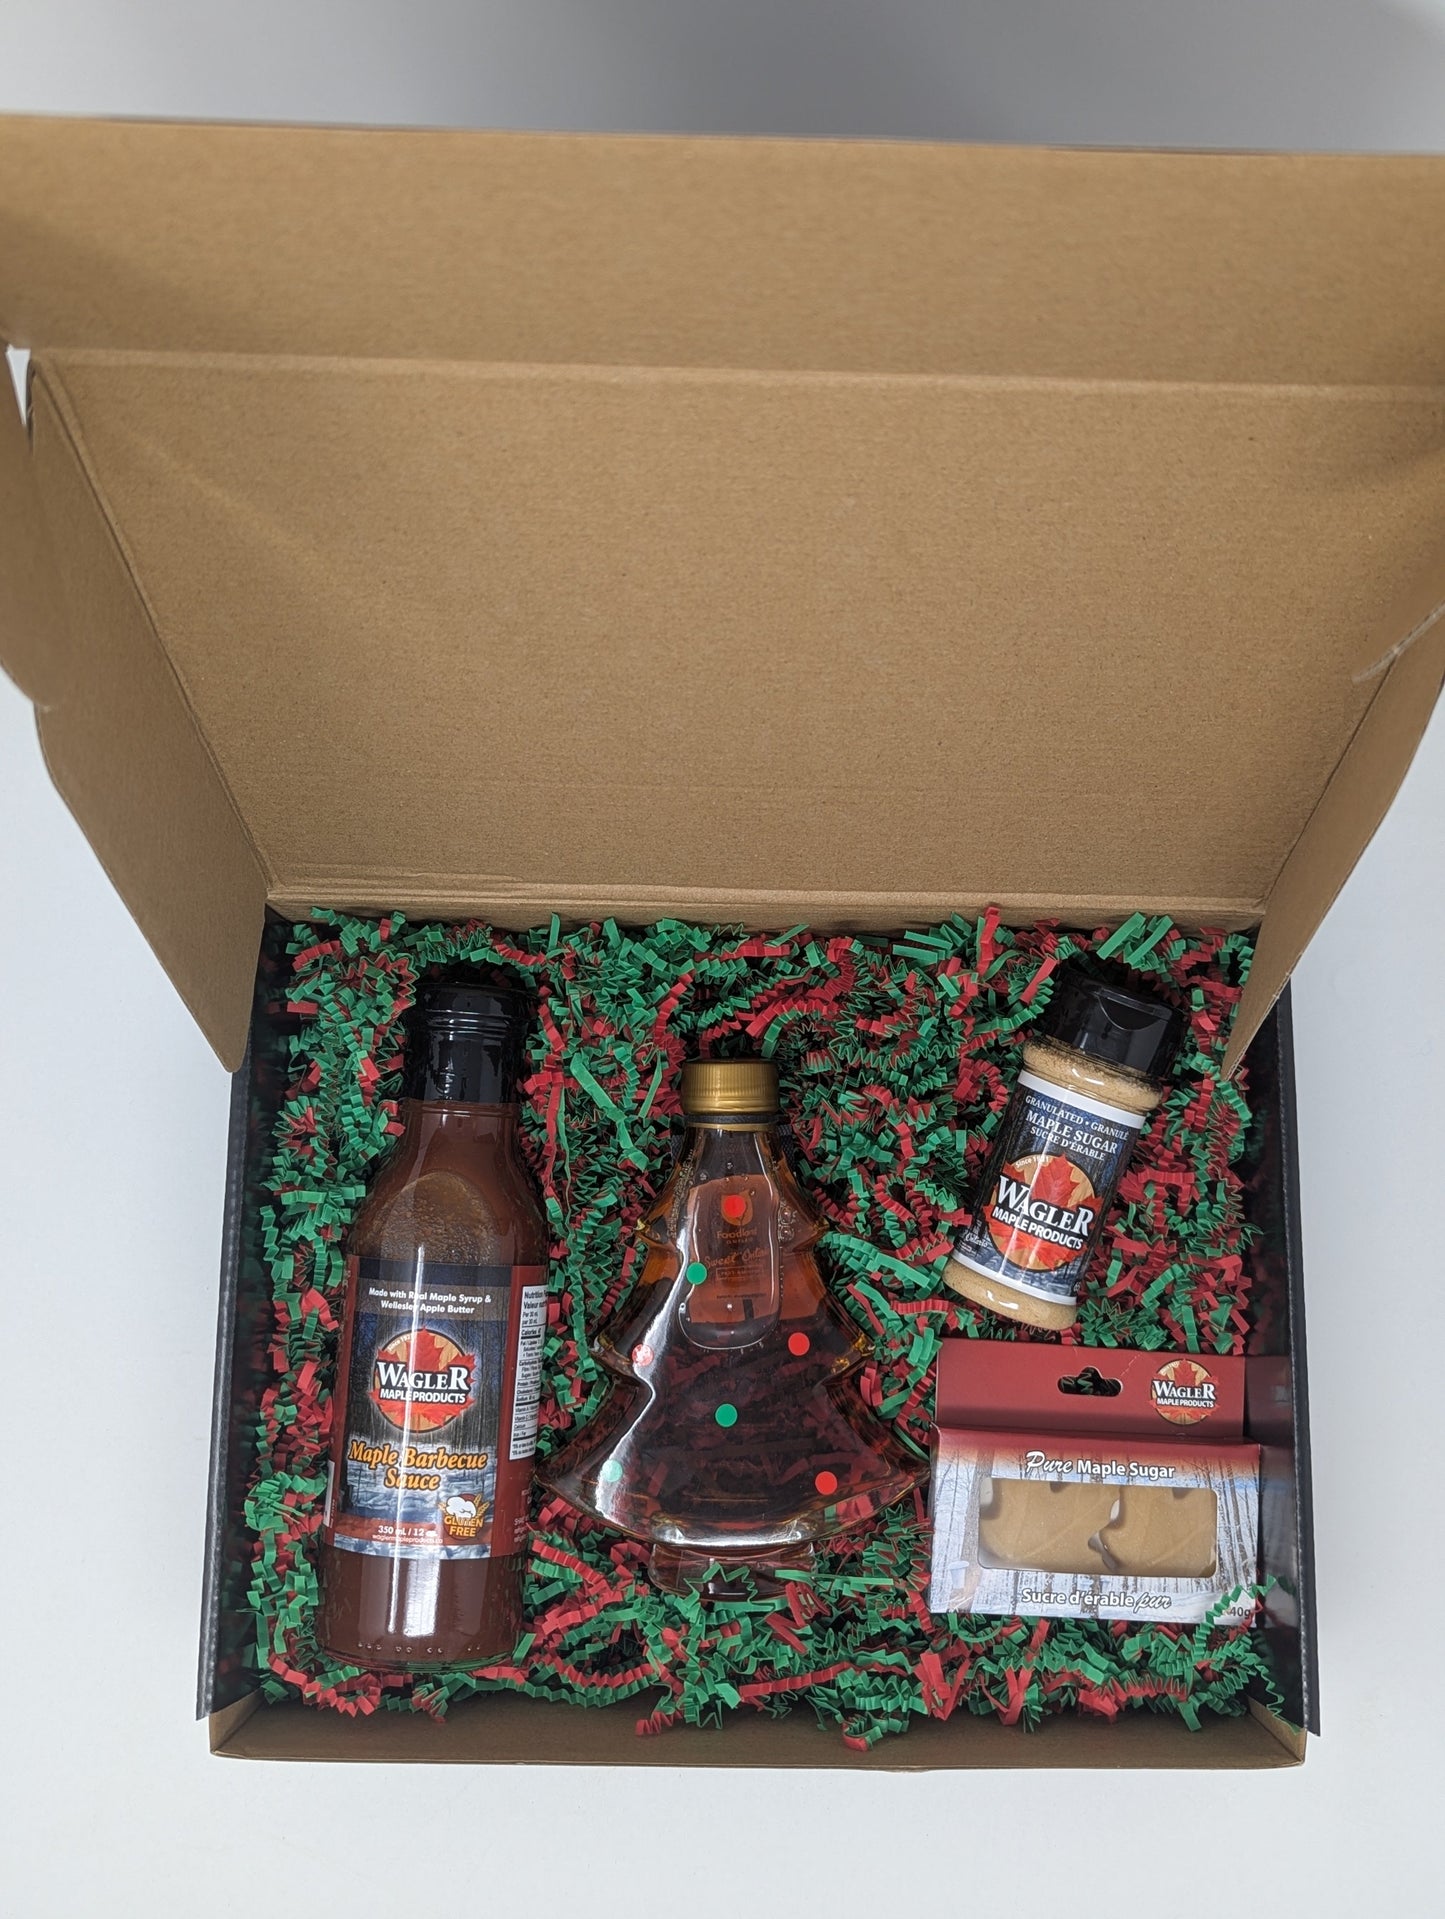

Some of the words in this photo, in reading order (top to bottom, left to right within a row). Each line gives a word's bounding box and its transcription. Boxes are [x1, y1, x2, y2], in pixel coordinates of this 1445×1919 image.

[1025, 1095, 1083, 1125] GRANULATED
[1090, 1121, 1129, 1141] GRANULÉ
[1025, 1109, 1073, 1138] MAPLE
[1073, 1130, 1118, 1154] SUGAR
[1030, 1126, 1060, 1145] SUCRE
[1060, 1138, 1106, 1161] D'ÉRABLE
[997, 1175, 1094, 1236] WAGLER
[991, 1206, 1029, 1231] MAPLE
[1028, 1222, 1084, 1250] PRODUCTS
[369, 1287, 388, 1297] Made
[390, 1289, 406, 1299] with
[429, 1293, 457, 1303] Maple
[459, 1294, 483, 1305] Syrup
[485, 1295, 491, 1303] &
[420, 1304, 446, 1314] Apple
[447, 1304, 475, 1314] Butter
[376, 1361, 470, 1391] WAGLER
[380, 1388, 412, 1401] MAPLE
[413, 1390, 466, 1404] PRODUCTS
[1152, 1380, 1216, 1400] WAGLER
[1156, 1398, 1179, 1406] MAPLE
[1179, 1399, 1214, 1408] PRODUCTS
[349, 1440, 399, 1469] Maple
[403, 1447, 487, 1469] Barbecue
[1026, 1451, 1073, 1473] Pure
[1076, 1459, 1126, 1477] Maple
[1129, 1462, 1175, 1480] Sugar
[384, 1467, 441, 1490] Sauce
[378, 1525, 394, 1535] 350
[413, 1528, 424, 1536] 12
[444, 1516, 483, 1527] GLUTEN
[449, 1527, 477, 1537] FREE
[1022, 1588, 1066, 1604] Sucre
[1069, 1590, 1135, 1607] d'érable
[1134, 1593, 1172, 1613] pur
[1230, 1606, 1251, 1618] 40g
